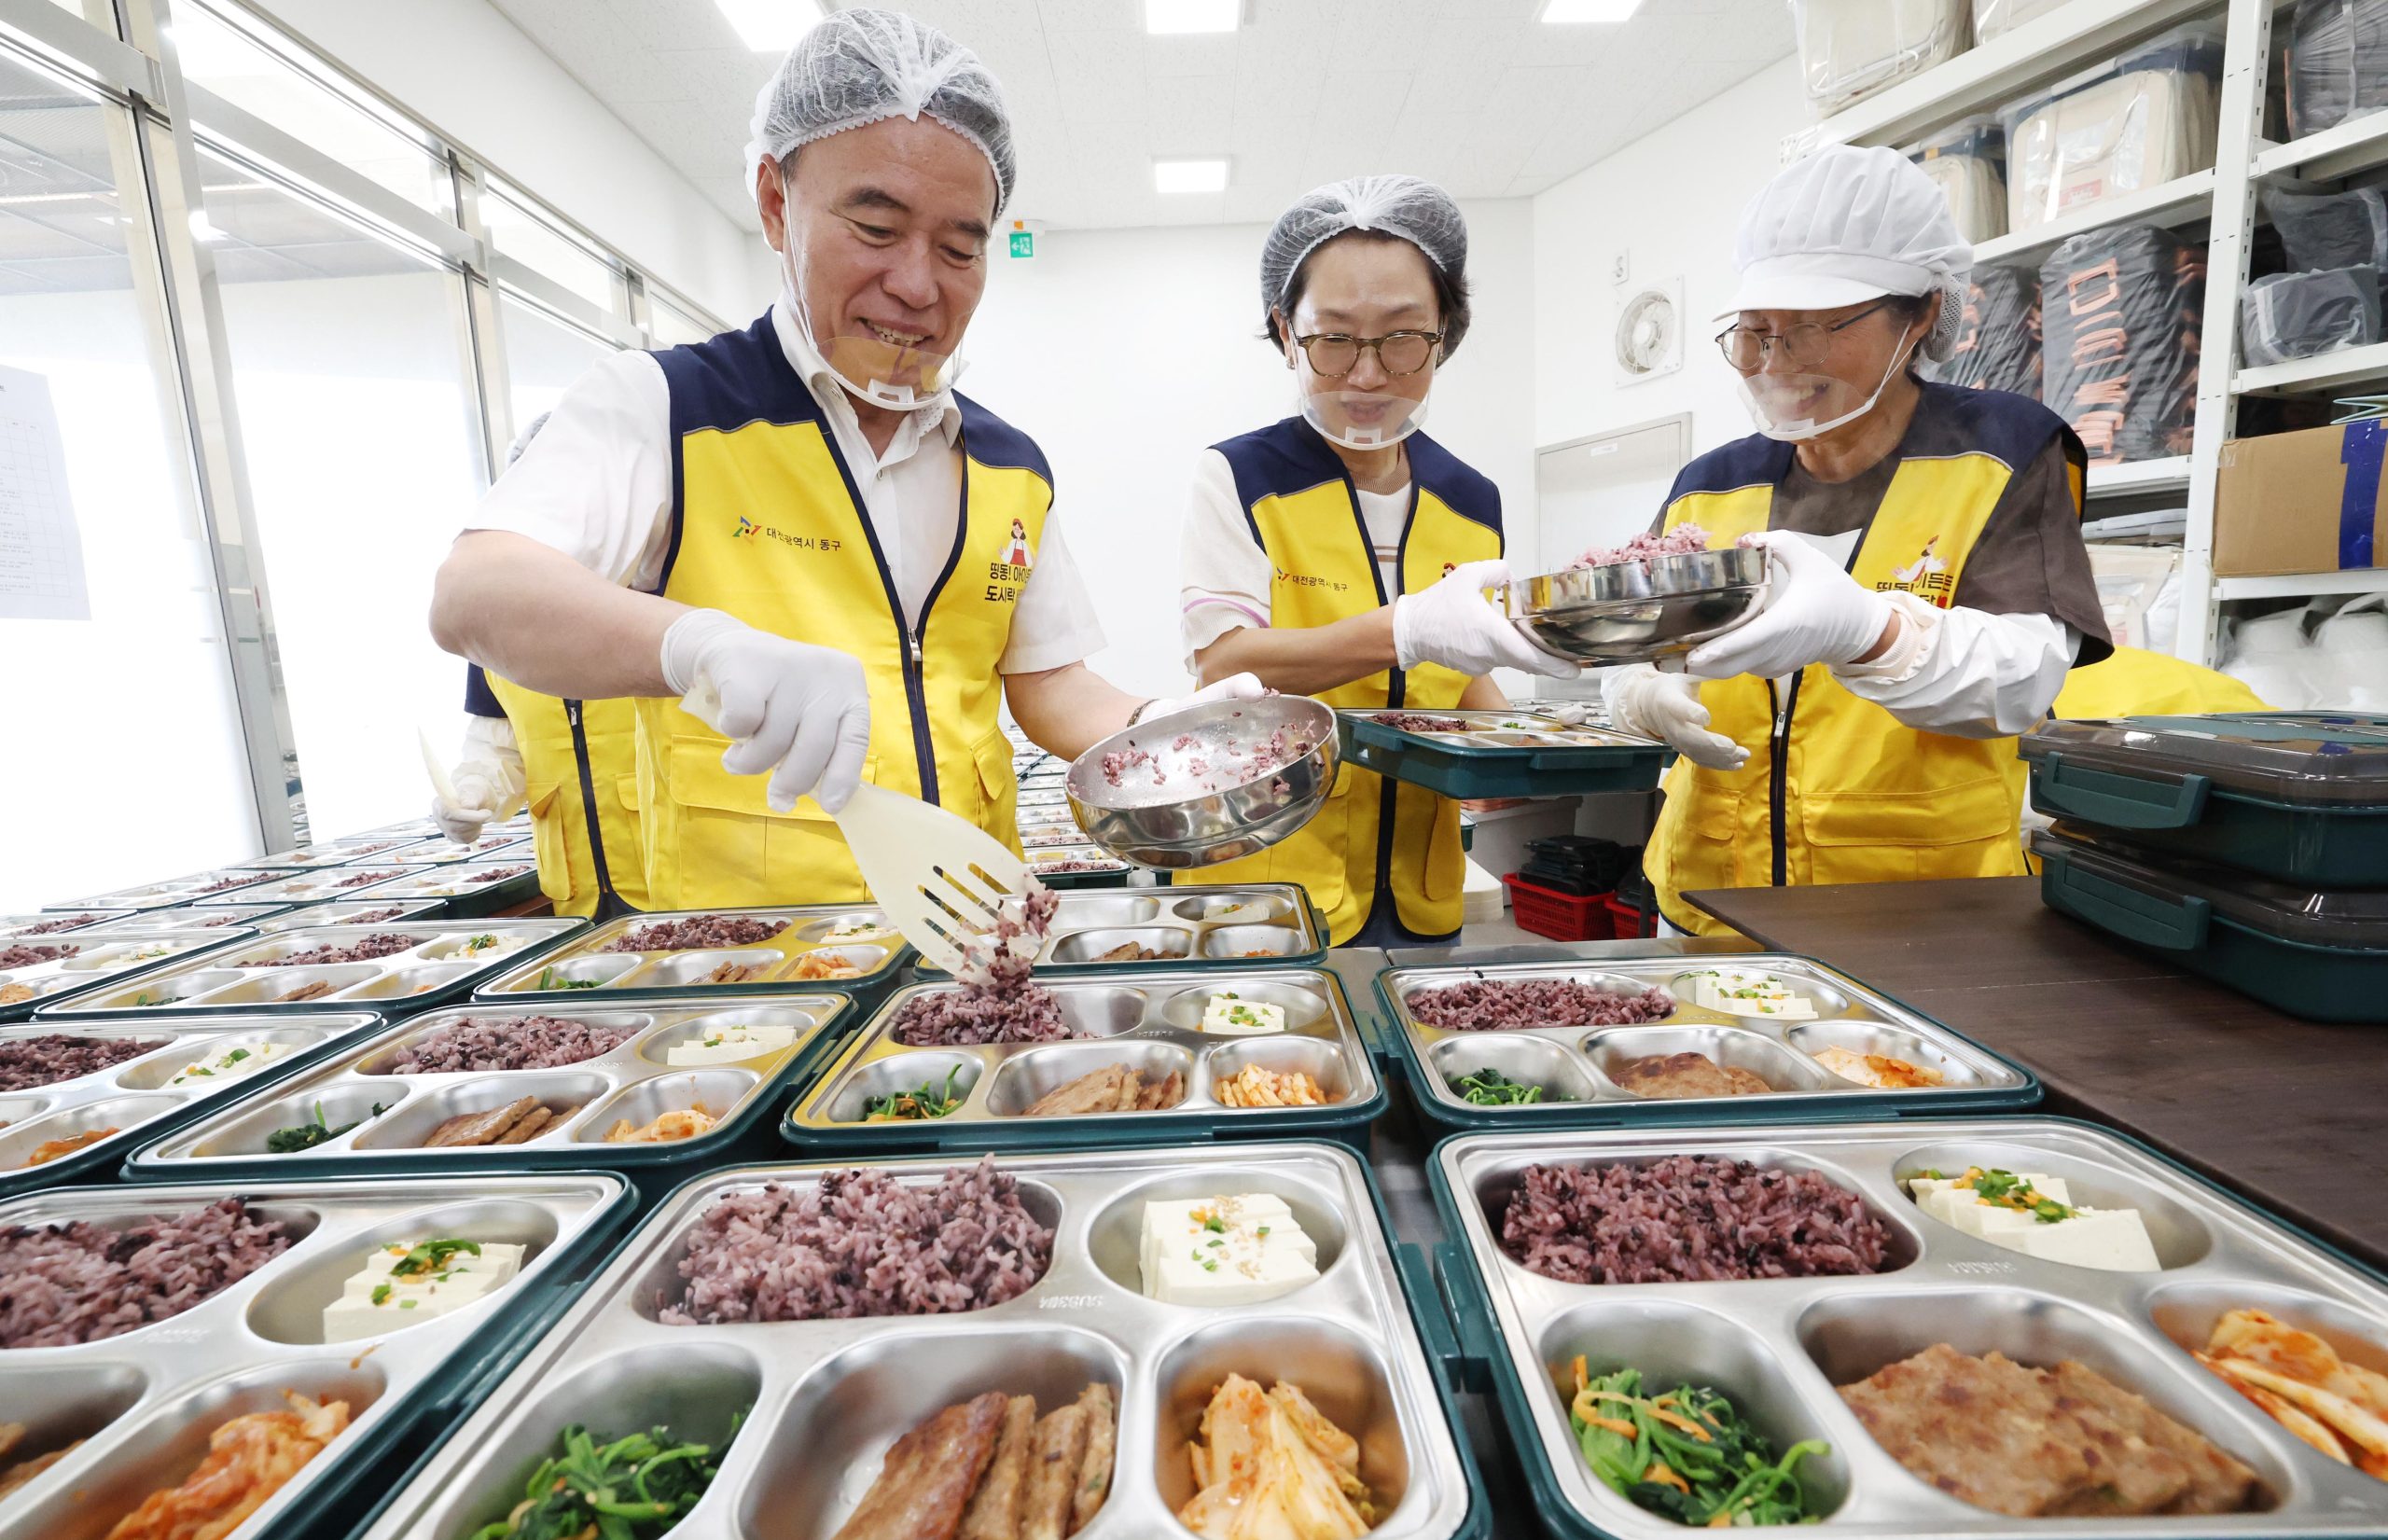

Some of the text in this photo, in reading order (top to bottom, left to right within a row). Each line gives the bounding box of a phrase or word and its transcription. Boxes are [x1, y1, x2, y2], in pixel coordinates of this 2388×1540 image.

[767, 528, 842, 551] 대전광역시 동구
[990, 562, 1011, 581] 띵동!
[1292, 576, 1348, 592] 대전광역시 동구
[984, 585, 1016, 604] 도시락
